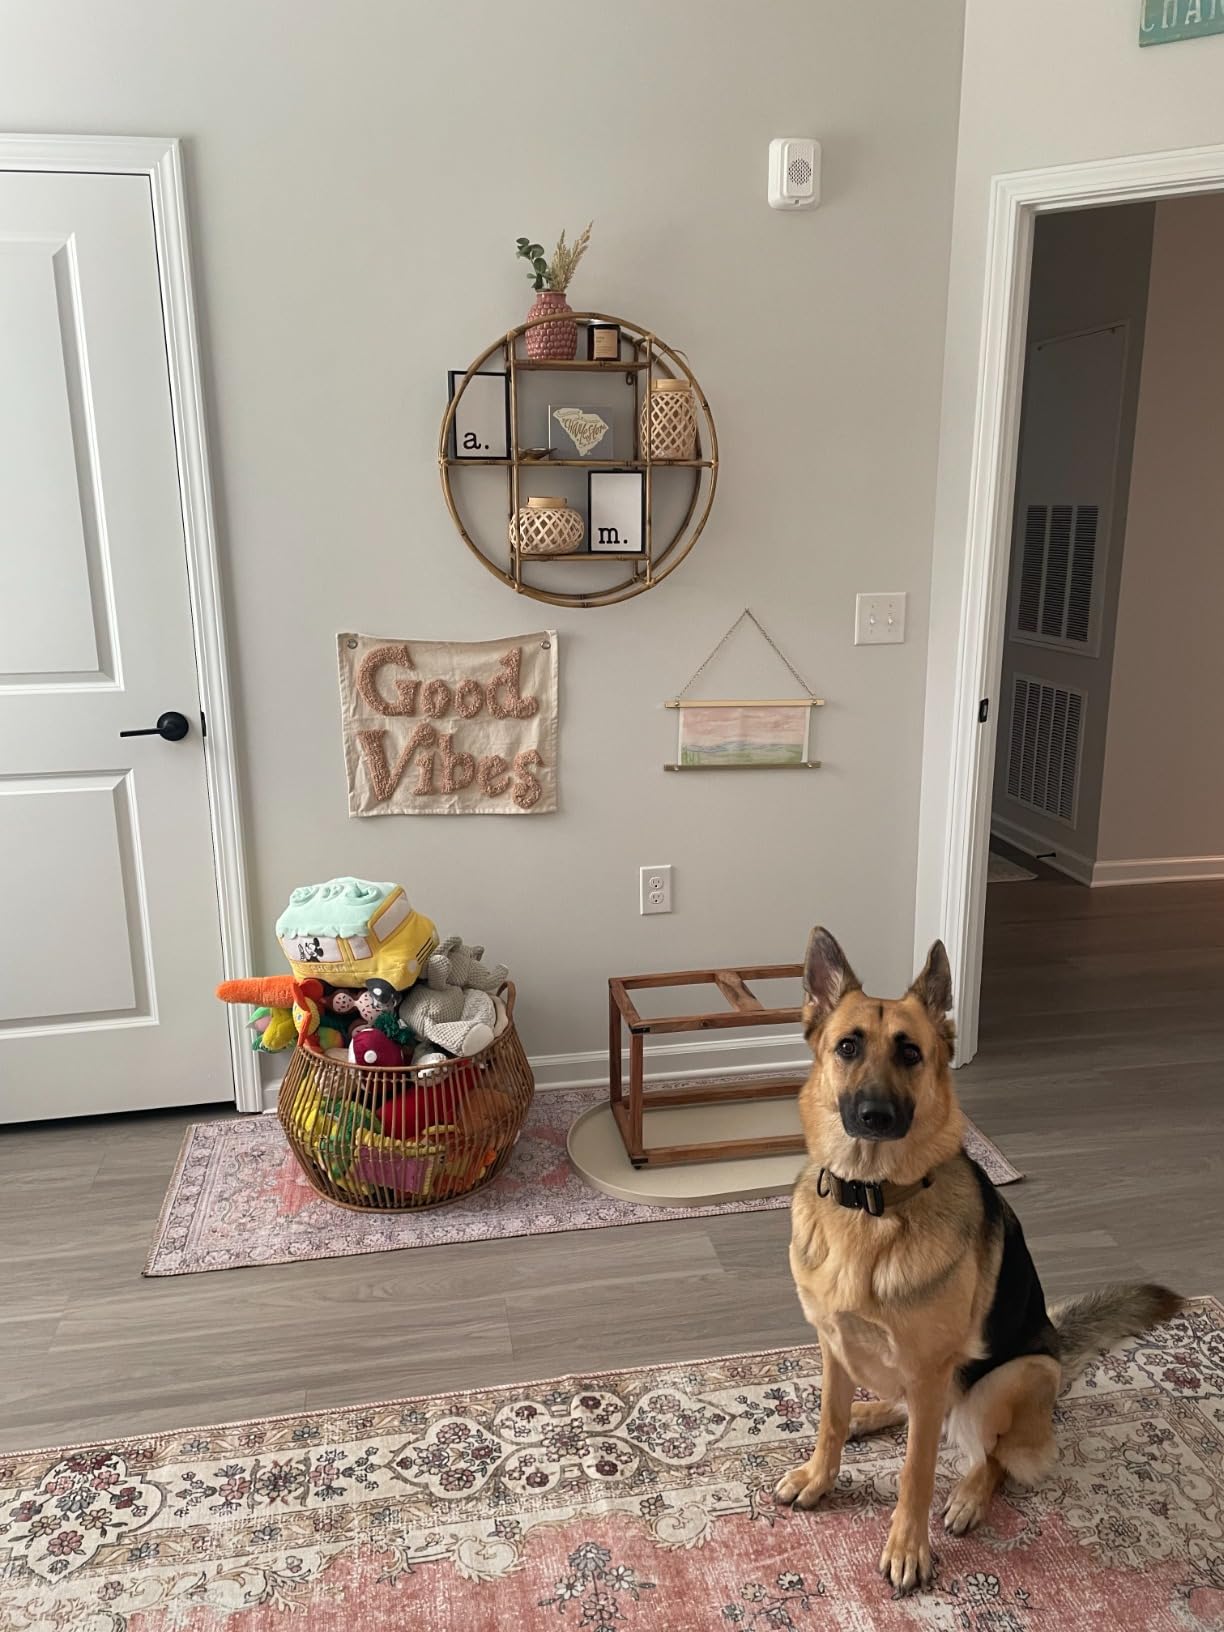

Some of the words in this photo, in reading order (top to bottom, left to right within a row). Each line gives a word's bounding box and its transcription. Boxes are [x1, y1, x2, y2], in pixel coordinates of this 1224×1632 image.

[463, 432, 490, 450] a.
[598, 527, 628, 544] m.
[357, 644, 540, 720] Good
[357, 722, 545, 810] Vibes
